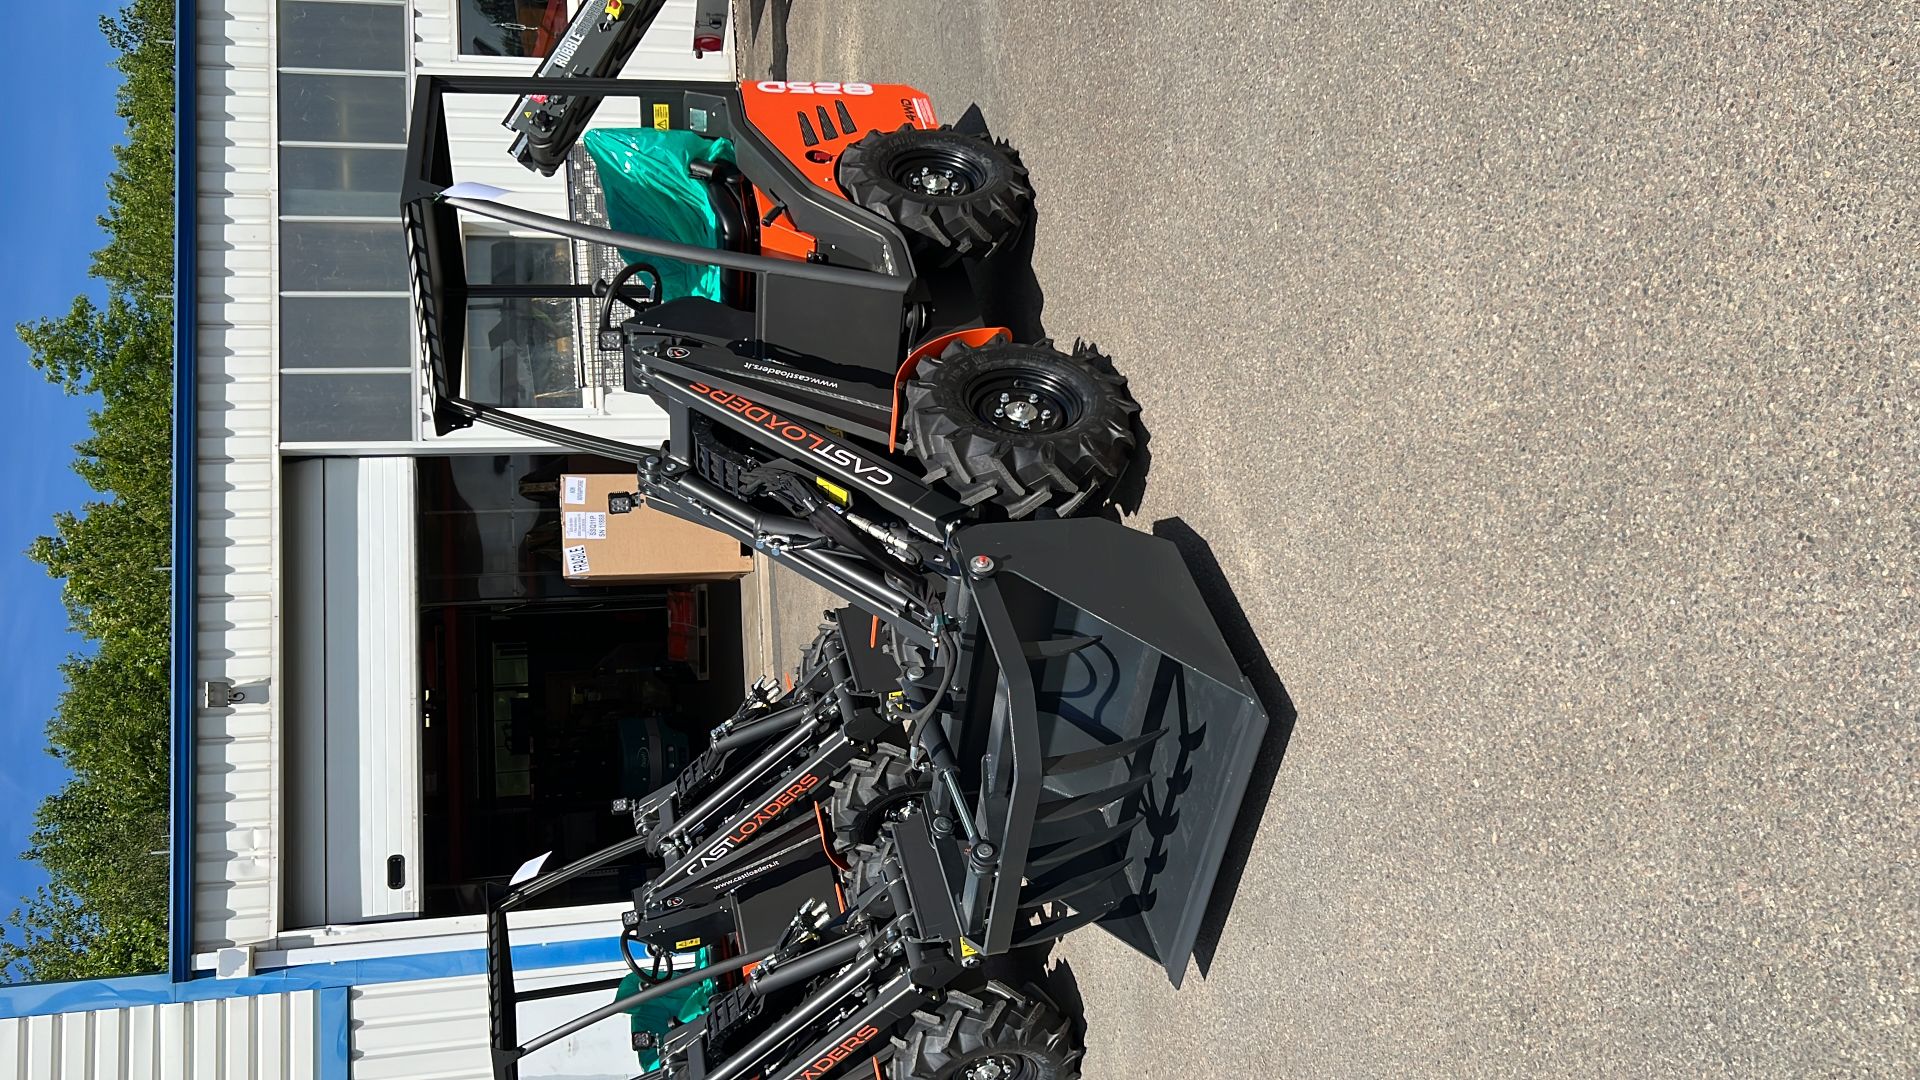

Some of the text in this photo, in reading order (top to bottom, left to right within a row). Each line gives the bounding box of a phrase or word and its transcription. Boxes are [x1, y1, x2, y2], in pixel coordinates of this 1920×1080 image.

[757, 81, 874, 96] 825D
[900, 98, 916, 121] 4WD
[744, 362, 838, 388] www.castloaders.it
[569, 546, 589, 572] FRAGILE
[686, 774, 818, 876] CASTLOADERS
[714, 860, 780, 890] www.castloaders.it
